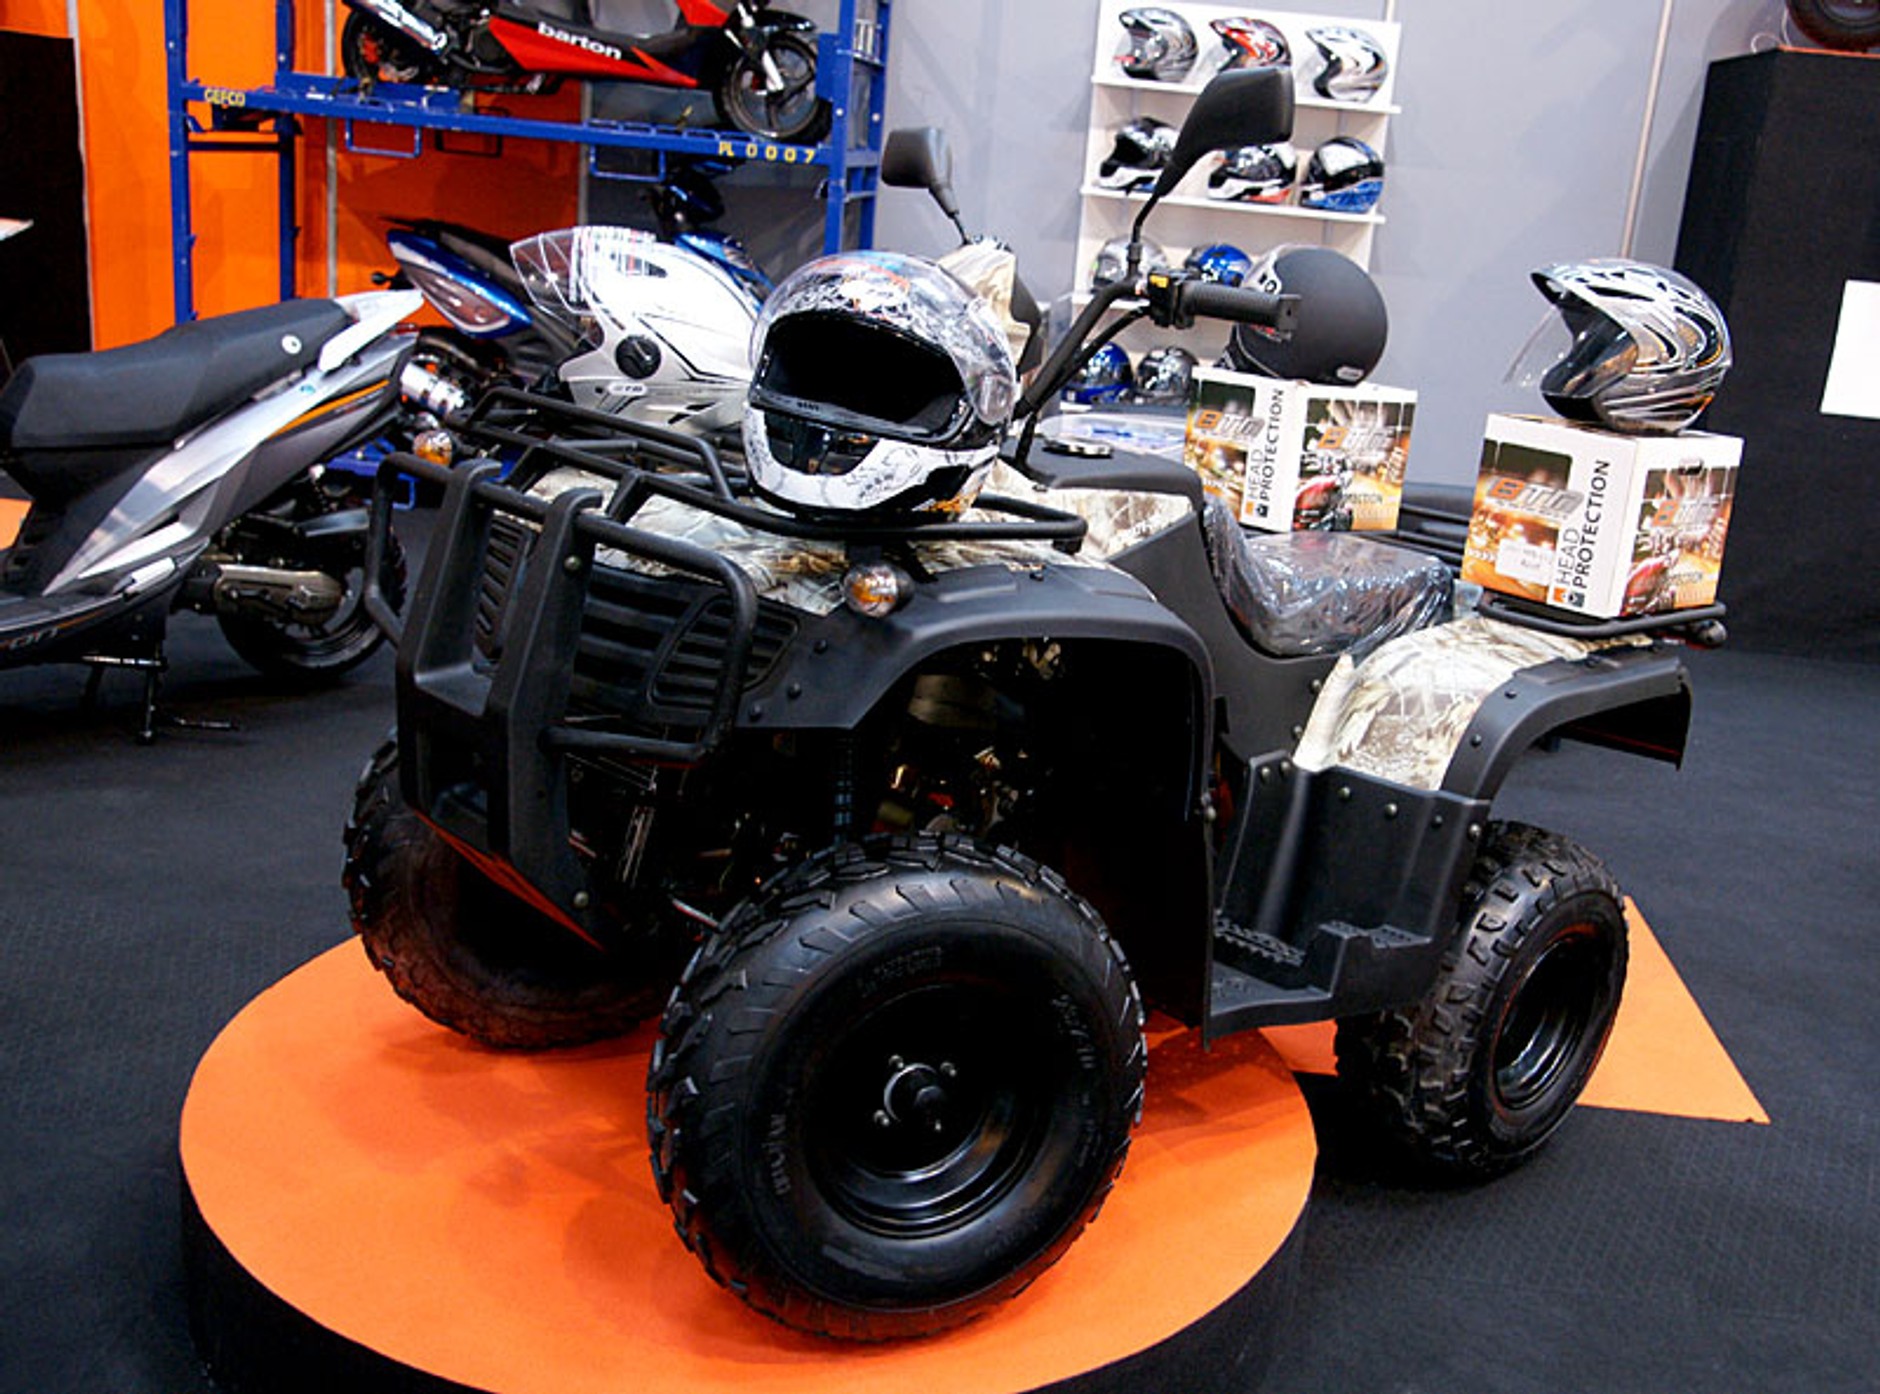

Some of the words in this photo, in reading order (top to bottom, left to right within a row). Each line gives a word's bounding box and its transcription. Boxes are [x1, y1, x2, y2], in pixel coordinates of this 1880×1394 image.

[537, 20, 622, 61] barton
[1246, 448, 1264, 500] HEAD
[1259, 388, 1285, 502] PROTECTION
[1572, 458, 1611, 589] PROTECTION
[1555, 527, 1580, 586] HEAD
